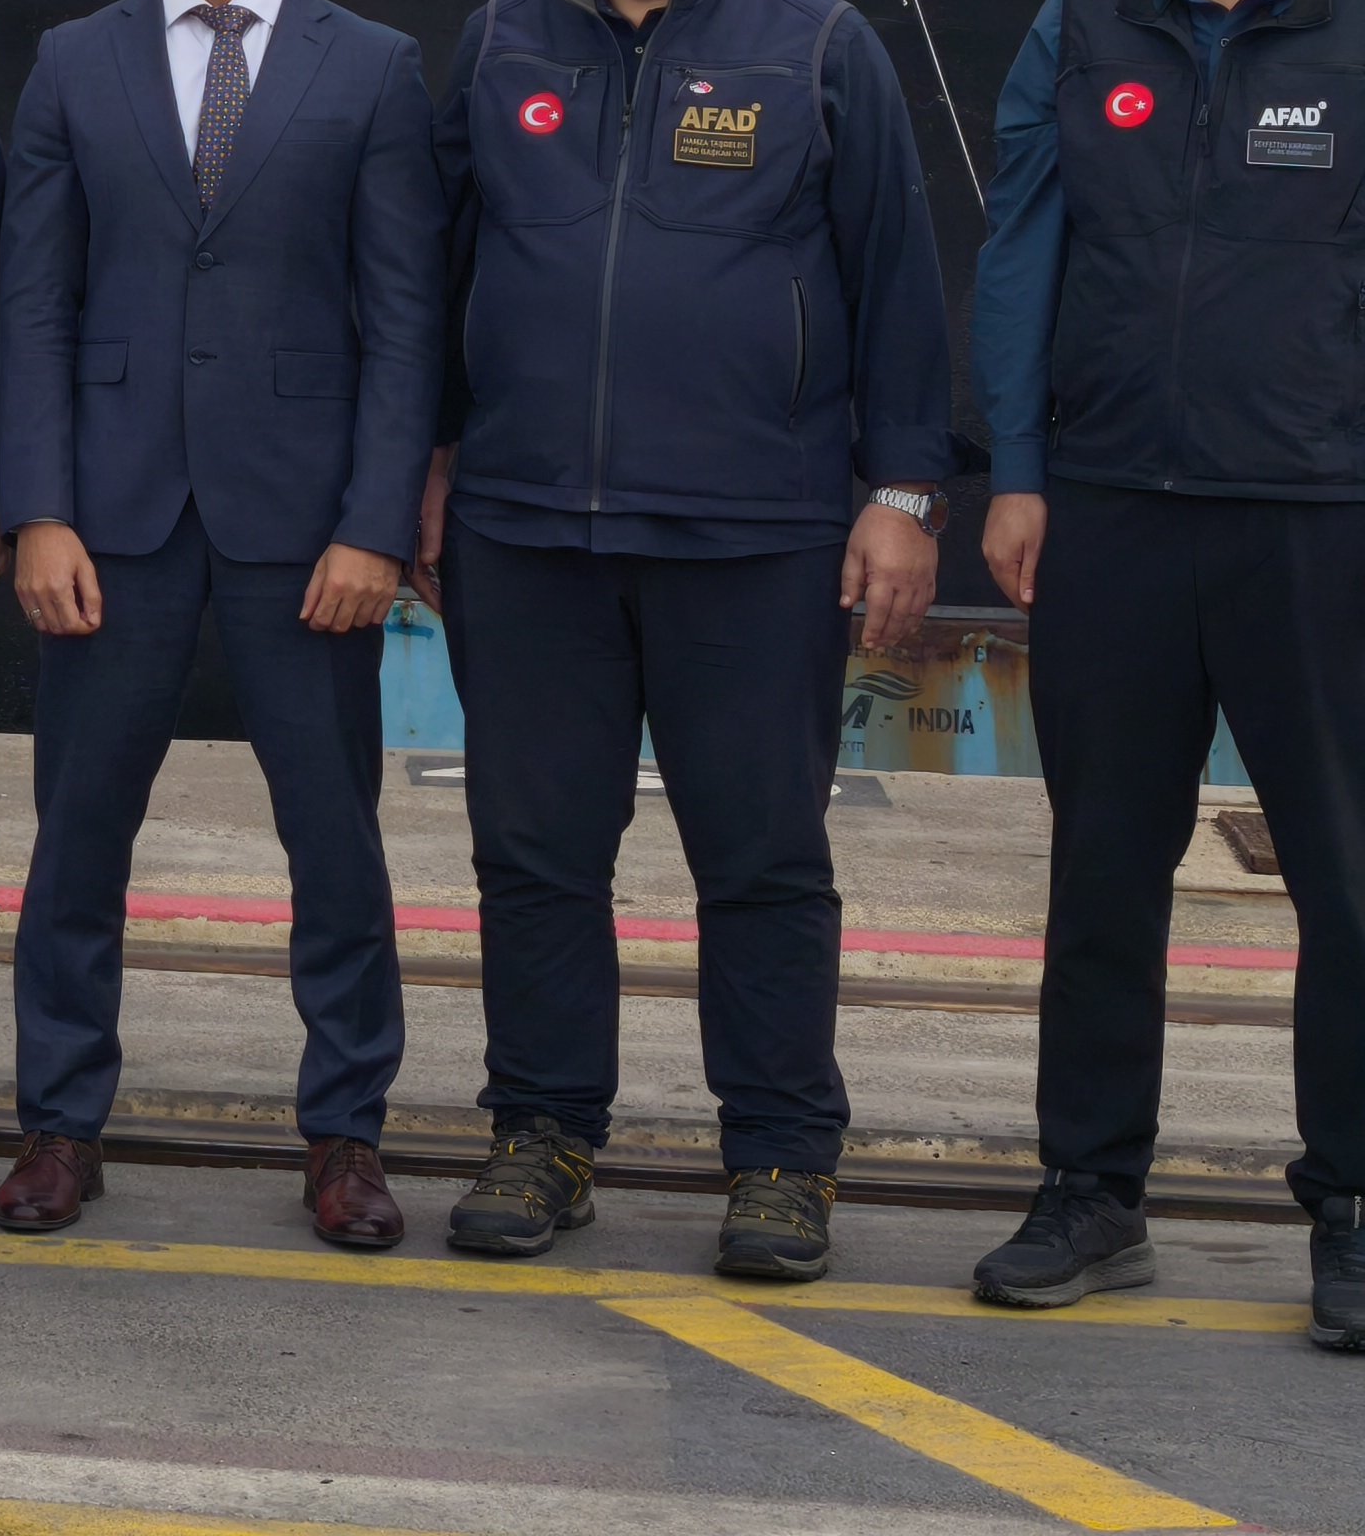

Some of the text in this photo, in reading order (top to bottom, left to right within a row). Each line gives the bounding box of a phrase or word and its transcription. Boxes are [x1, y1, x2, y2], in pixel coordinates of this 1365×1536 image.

[680, 105, 757, 132] AFAD
[1258, 106, 1321, 126] AFAD
[908, 707, 975, 734] INDIA
